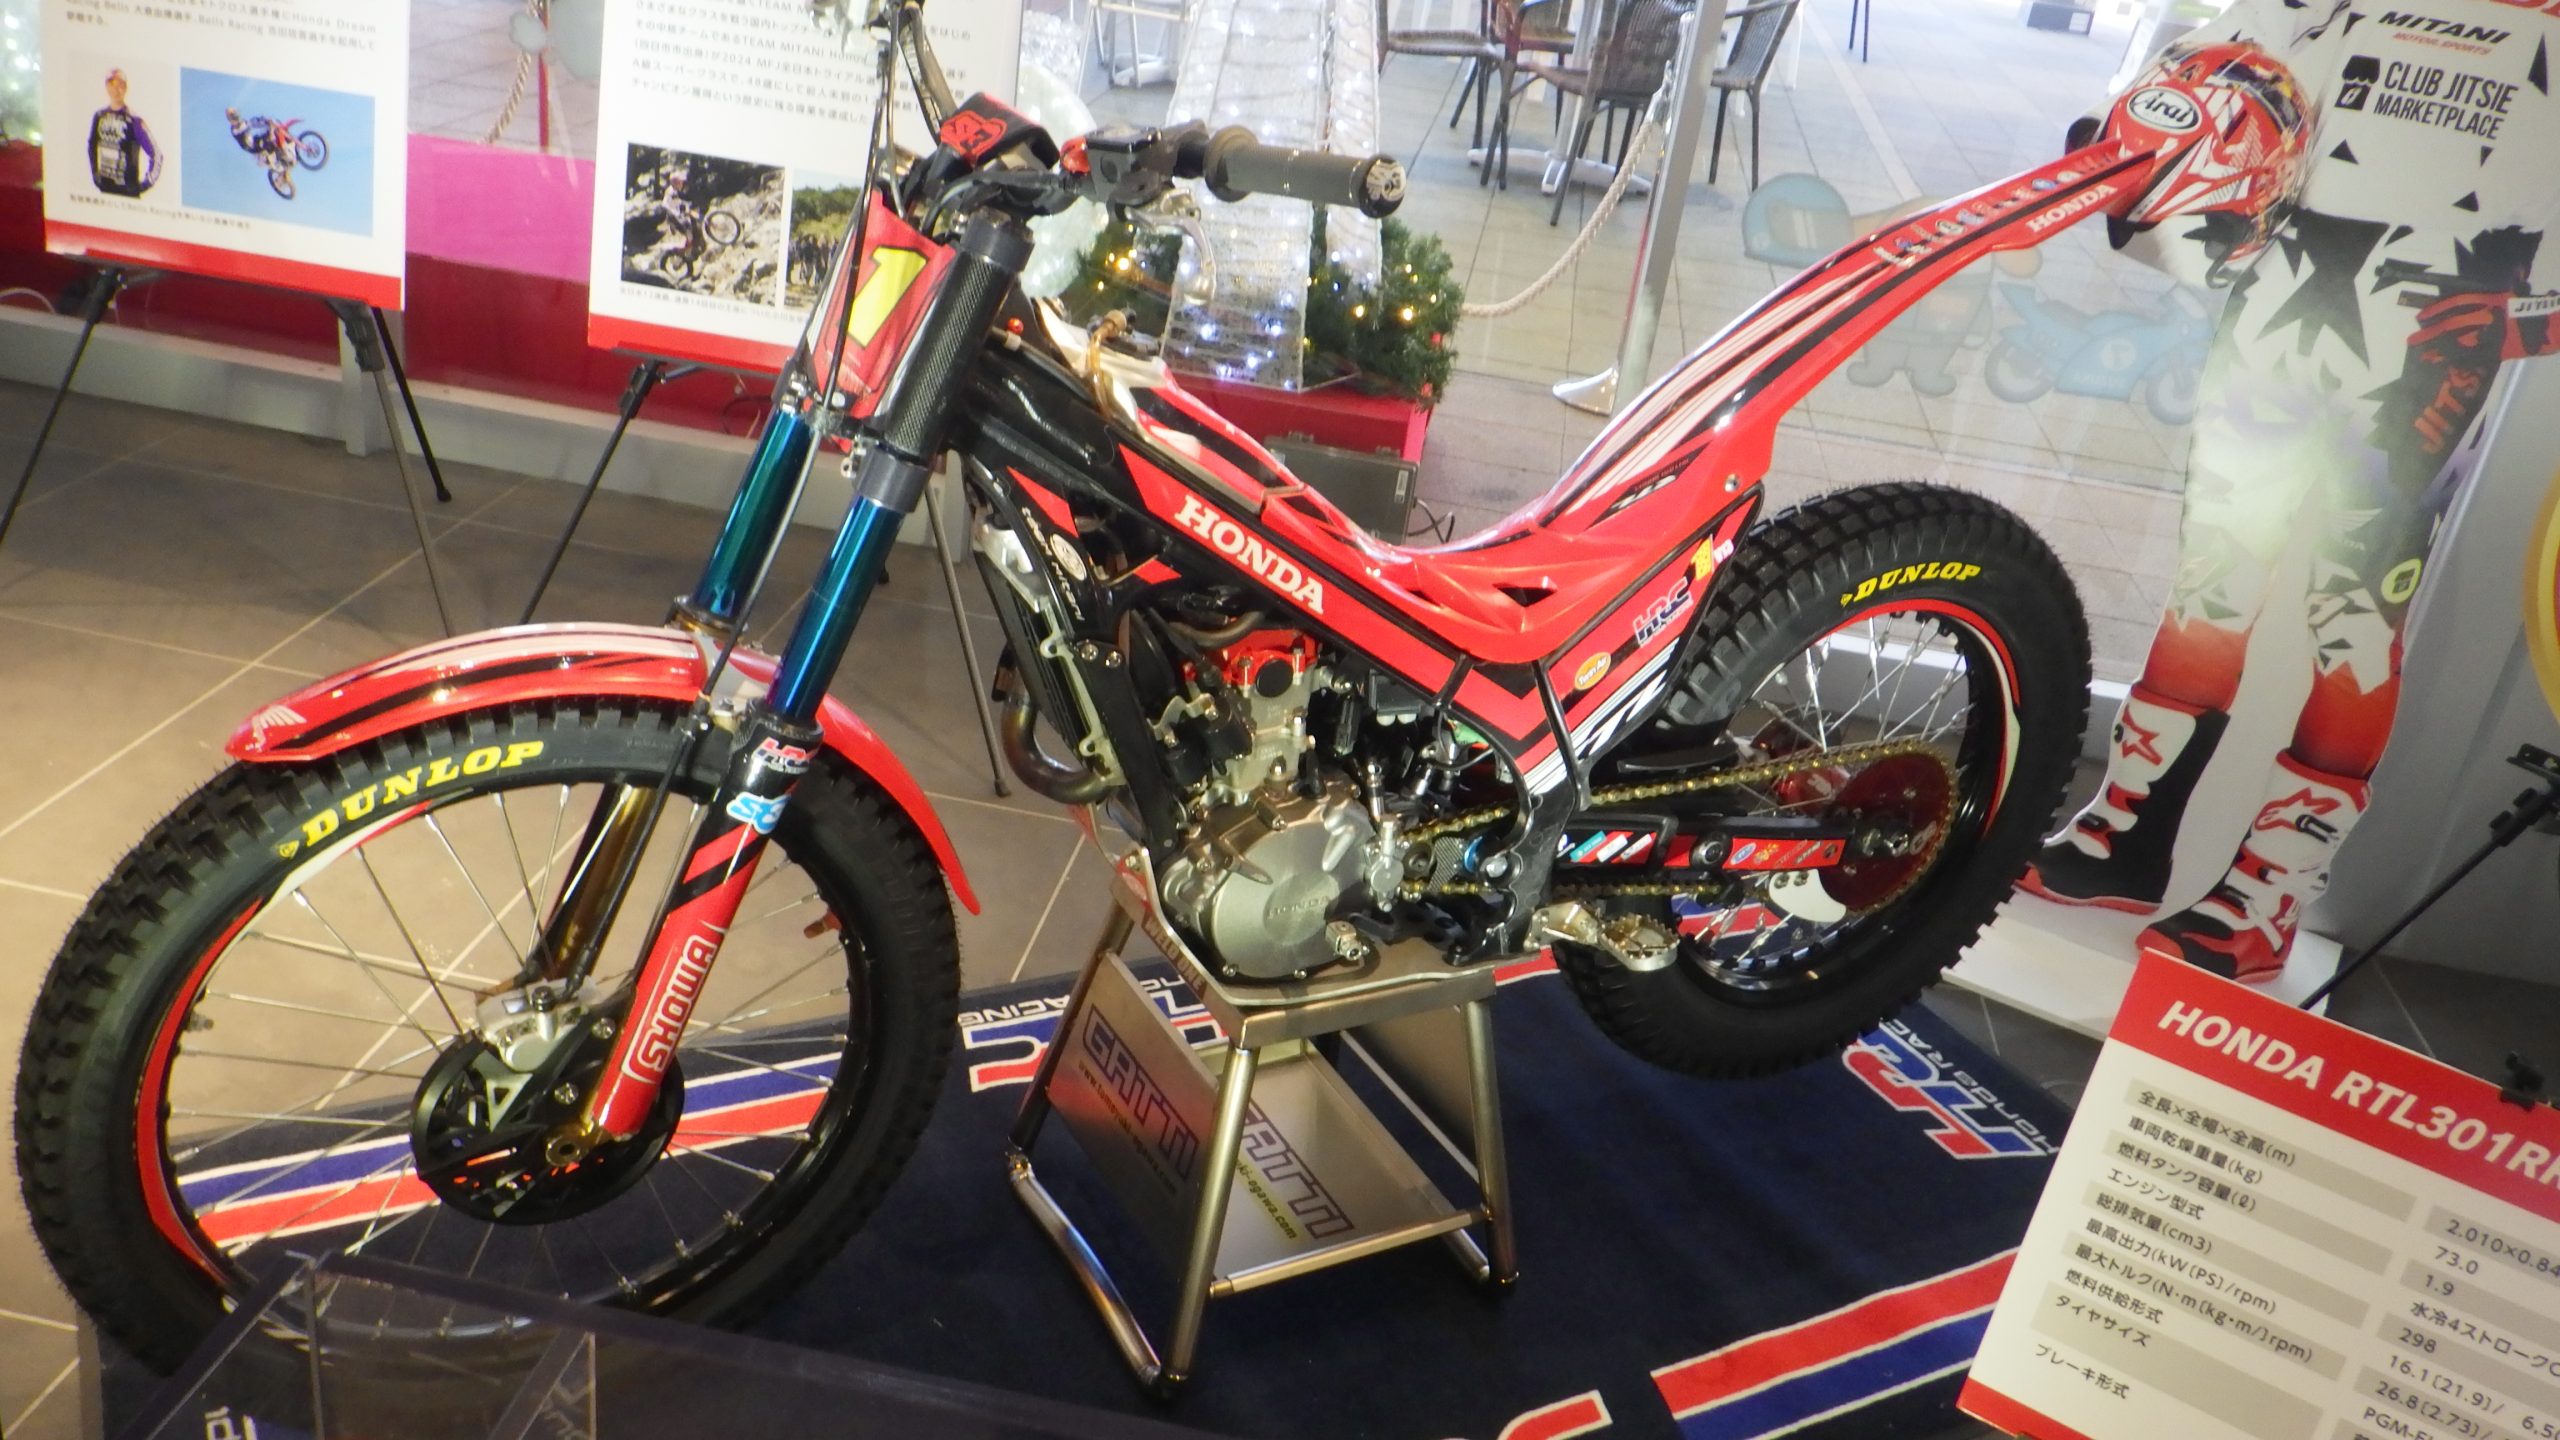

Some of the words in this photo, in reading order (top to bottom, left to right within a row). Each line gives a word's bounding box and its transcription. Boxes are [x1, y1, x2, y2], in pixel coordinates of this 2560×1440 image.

[2378, 11, 2512, 44] MITANI
[2133, 92, 2194, 123] Arai
[2384, 61, 2445, 102] CLUB
[2442, 72, 2520, 115] JITSIE
[2373, 92, 2505, 140] MARKETPLACE
[2025, 184, 2119, 233] HONDA
[847, 245, 928, 349] 1
[1174, 494, 1326, 615] HONDA
[1852, 561, 1982, 603] DUNLOP
[301, 739, 545, 848] DUNLOP
[636, 936, 717, 1073] SHOWA
[957, 994, 1071, 1027] ACING
[2157, 1000, 2326, 1092] HONDA
[1082, 1003, 1200, 1181] GATTI
[2107, 1167, 2206, 1222] エンジン型式
[2095, 1191, 2213, 1255] 総排気量(cm3)
[2424, 1273, 2455, 1297] 1.9
[2434, 1244, 2480, 1276] 73.0
[2055, 1294, 2152, 1348] タイヤサイズ
[2064, 1267, 2165, 1326] 燃料供給形式
[2399, 1326, 2438, 1354] 298
[2035, 1342, 2131, 1400] ブレーキ形式
